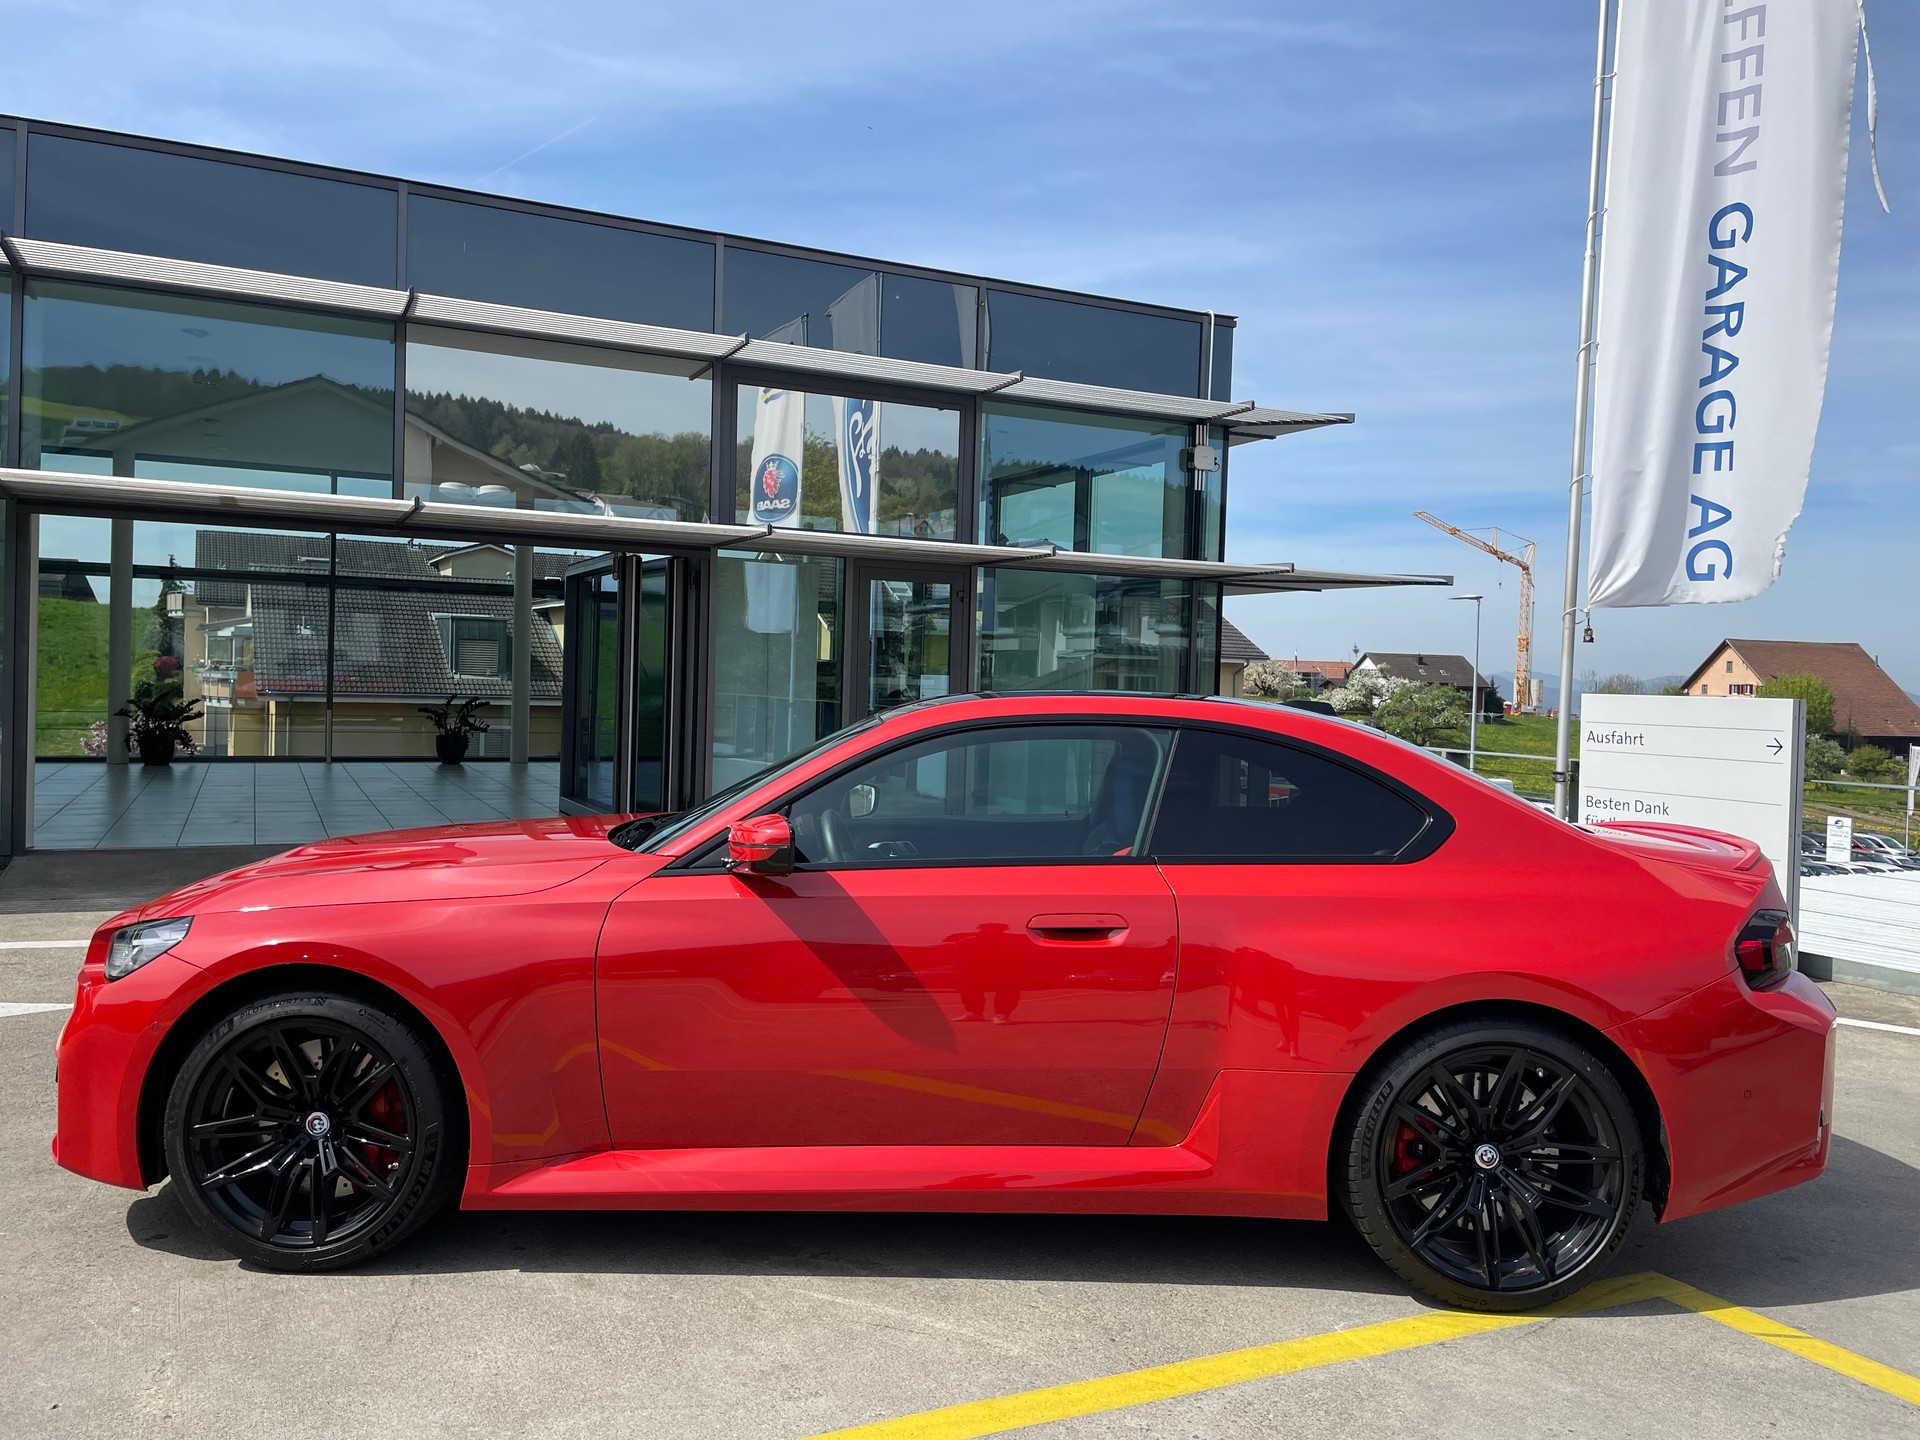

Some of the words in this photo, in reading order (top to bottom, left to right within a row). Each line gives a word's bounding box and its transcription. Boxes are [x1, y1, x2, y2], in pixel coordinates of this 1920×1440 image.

[1714, 0, 1766, 177] FFEN
[1692, 202, 1754, 475] GARAGE
[1686, 495, 1733, 581] AG
[1586, 730, 1644, 746] Ausfahrt
[1586, 795, 1630, 812] Besten
[1634, 799, 1670, 816] Dank
[1362, 1083, 1392, 1160] MICHELIN
[376, 1157, 433, 1241] MICHELIN
